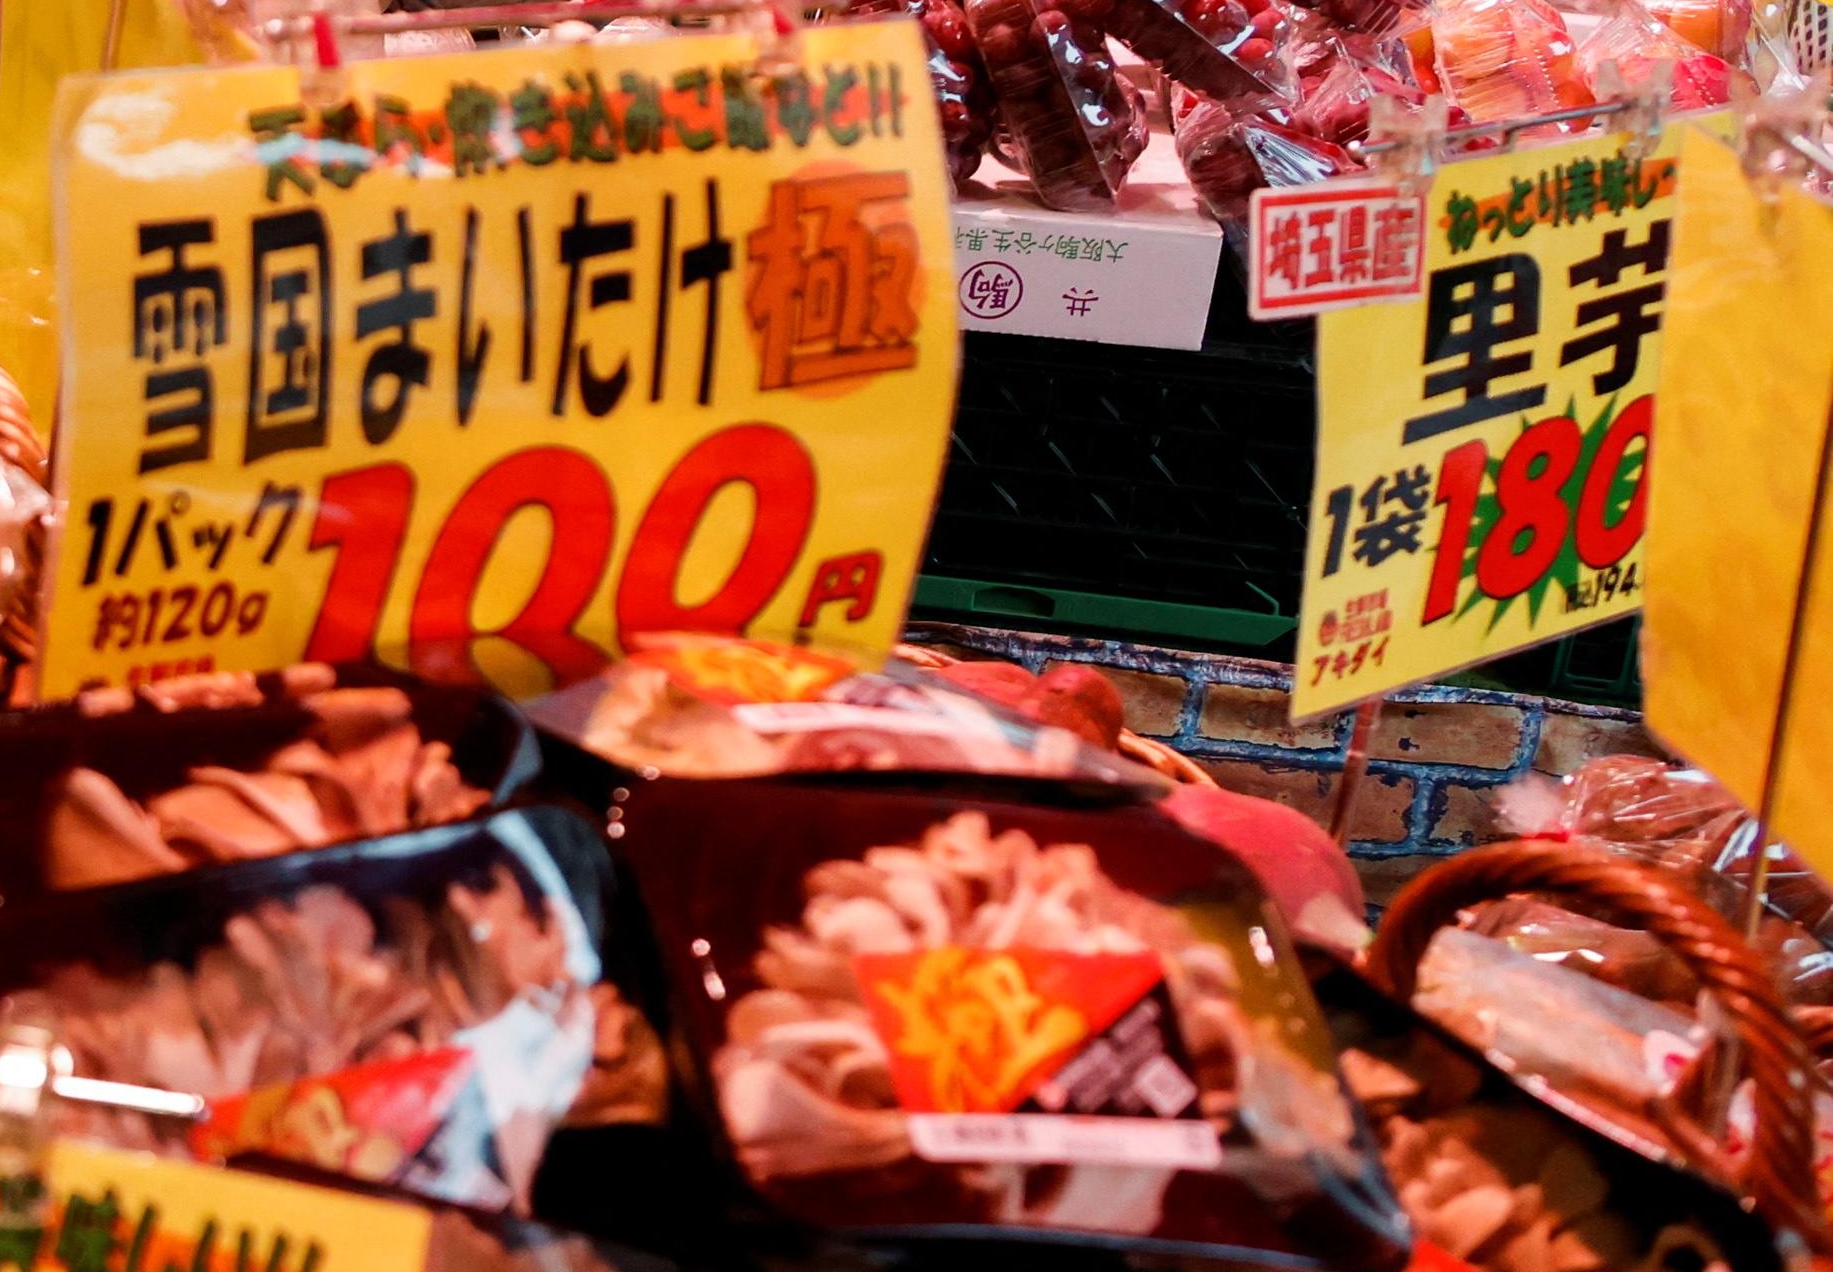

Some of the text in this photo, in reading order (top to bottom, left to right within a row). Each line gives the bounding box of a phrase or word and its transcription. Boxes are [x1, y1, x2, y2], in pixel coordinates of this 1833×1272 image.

[1266, 204, 1416, 290] 埼玉県産
[130, 175, 735, 476] 雪国まいたけ
[1401, 217, 1673, 447] 里芋
[81, 478, 309, 590] 1パック
[1322, 464, 1432, 580] 1袋
[93, 580, 268, 649] 約120g
[1310, 636, 1391, 688] アキダイ
